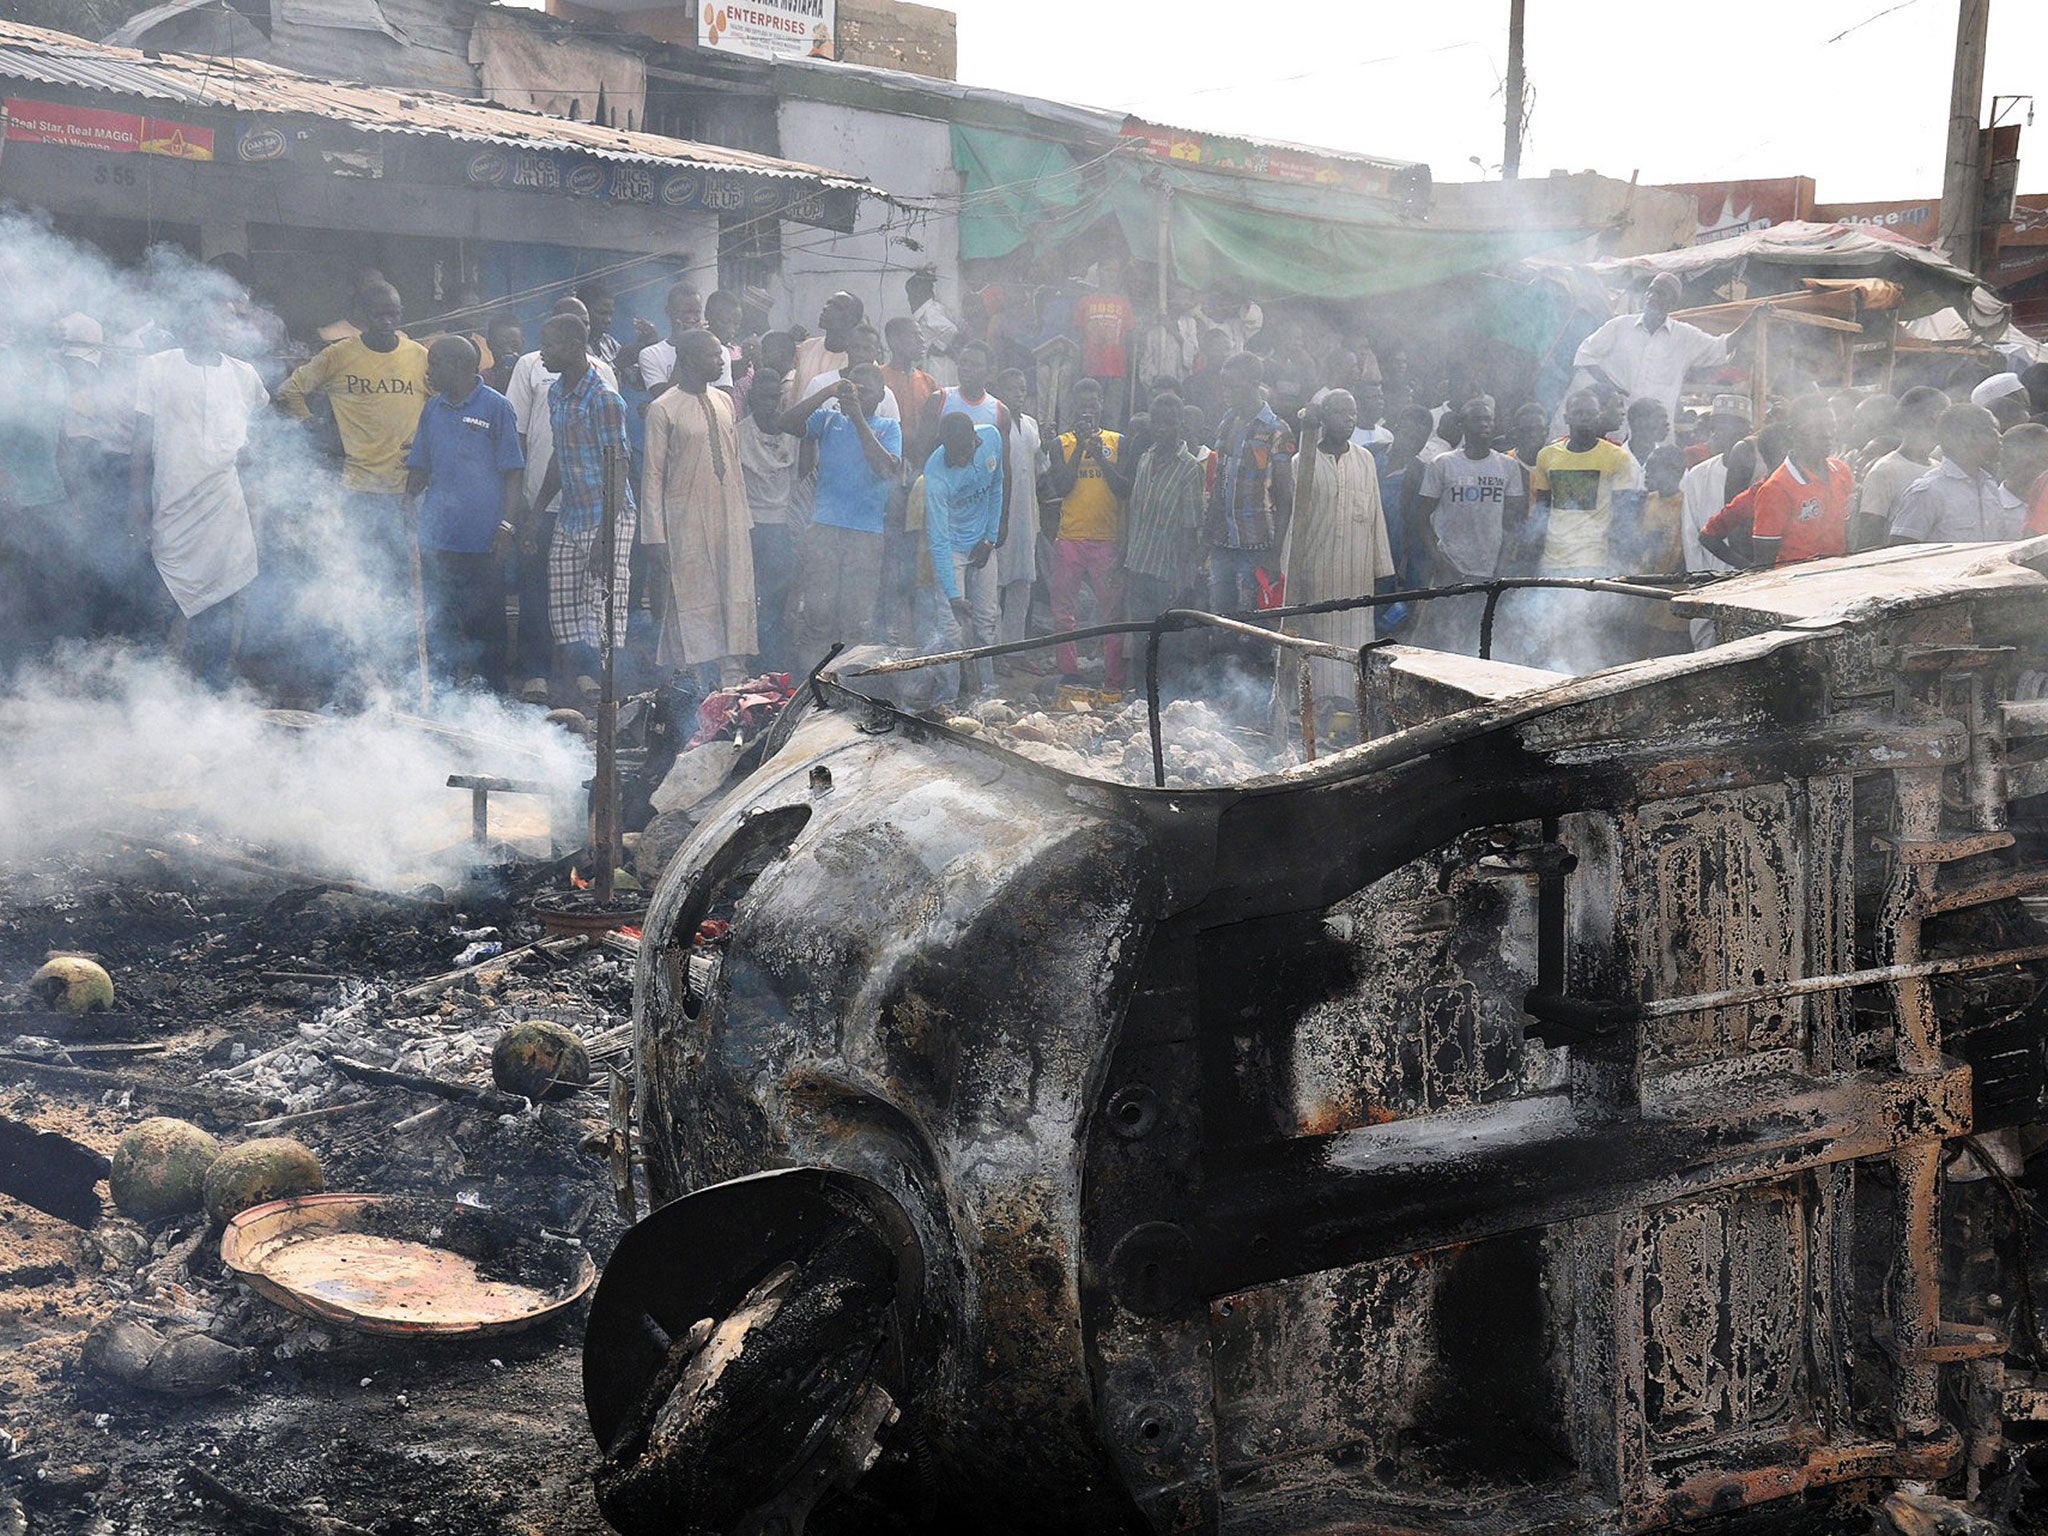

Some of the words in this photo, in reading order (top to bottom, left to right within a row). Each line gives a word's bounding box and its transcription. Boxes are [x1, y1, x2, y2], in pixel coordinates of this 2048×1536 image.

[727, 5, 805, 35] ENTERPRISES
[11, 117, 36, 130] Real
[67, 124, 92, 137] Real
[345, 374, 414, 396] PRADA
[1478, 476, 1505, 486] NEW
[1451, 486, 1504, 503] HOPE
